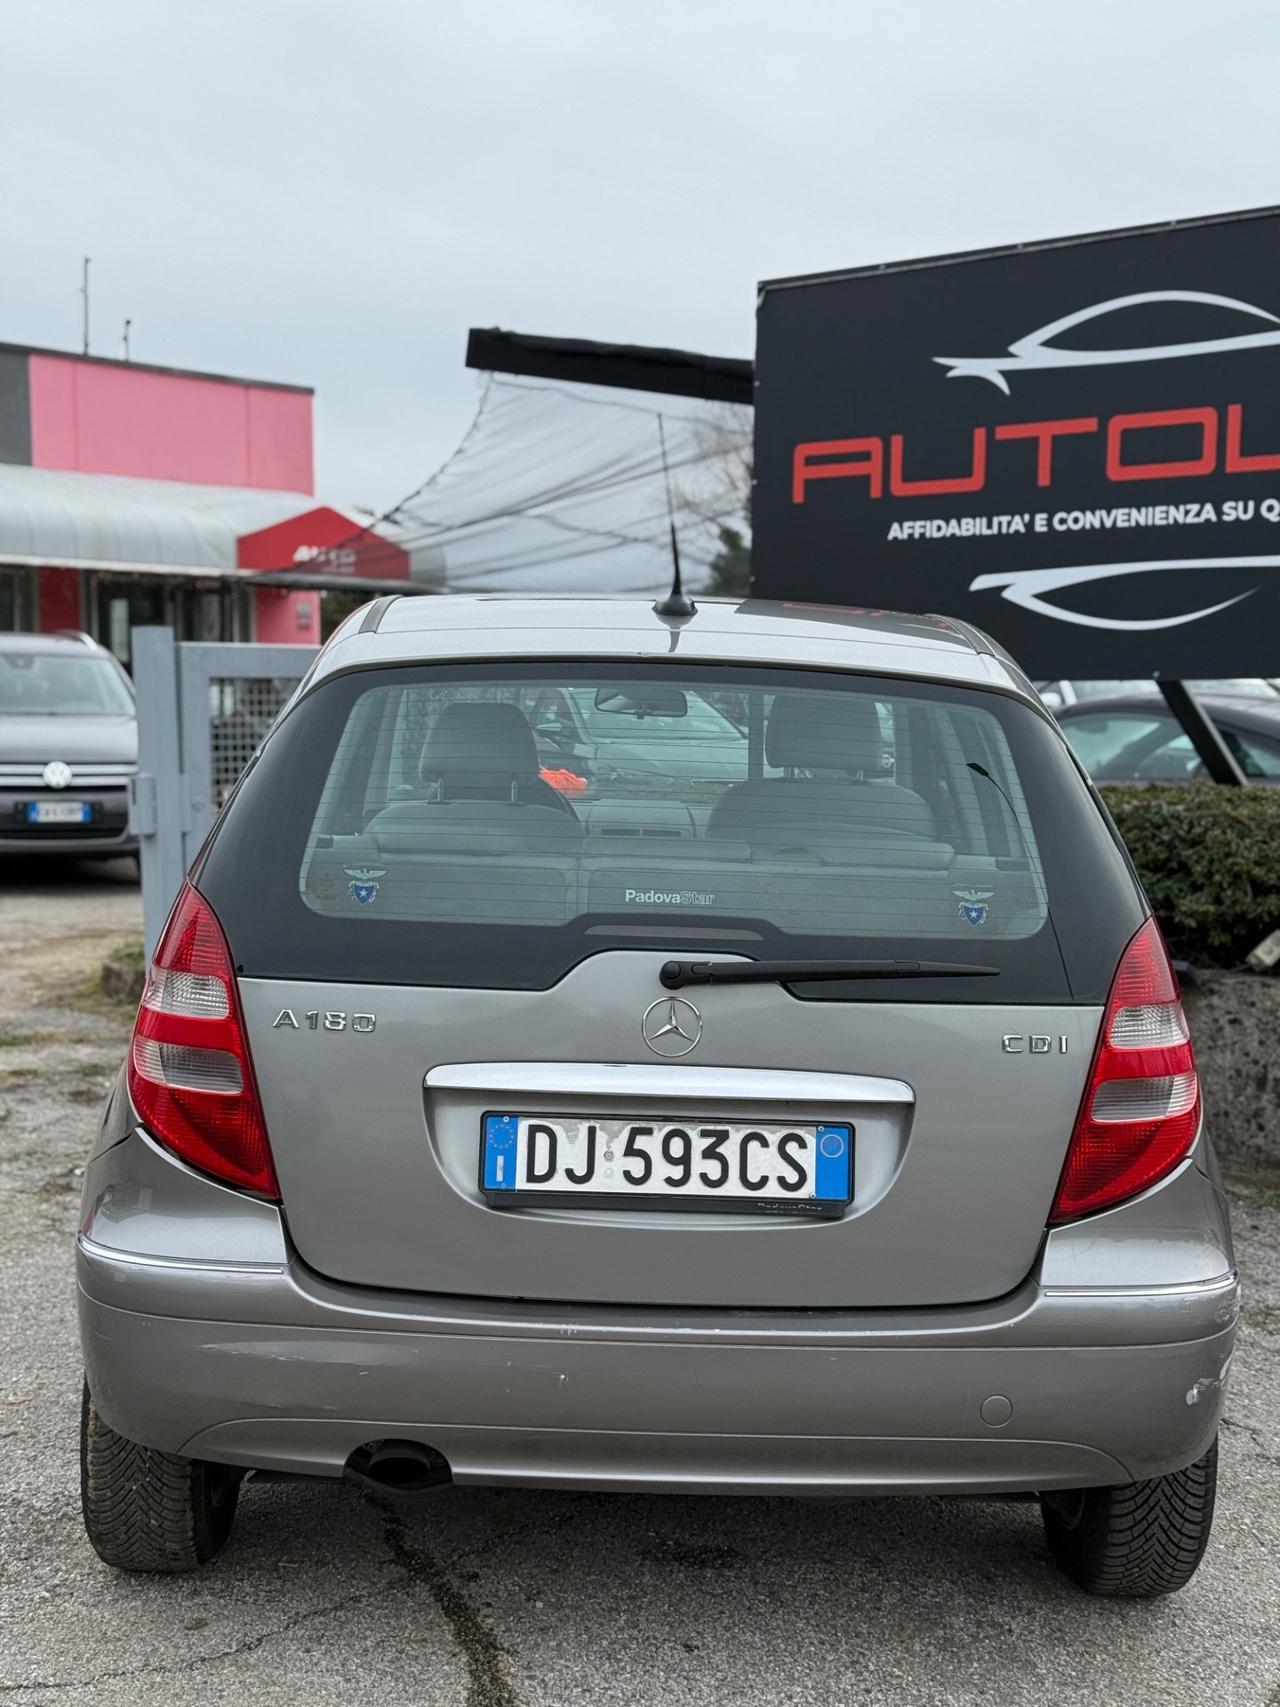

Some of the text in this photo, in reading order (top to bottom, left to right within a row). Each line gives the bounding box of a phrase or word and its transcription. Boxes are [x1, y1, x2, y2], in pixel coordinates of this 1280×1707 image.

[887, 513, 1030, 541] AFFIDABILITA'
[1034, 513, 1049, 533] E
[1052, 503, 1217, 532] CONVENIENZA
[1222, 500, 1255, 522] SU
[625, 889, 715, 905] PadovaStar
[272, 1009, 377, 1033] A180
[1002, 1034, 1068, 1054] CDI
